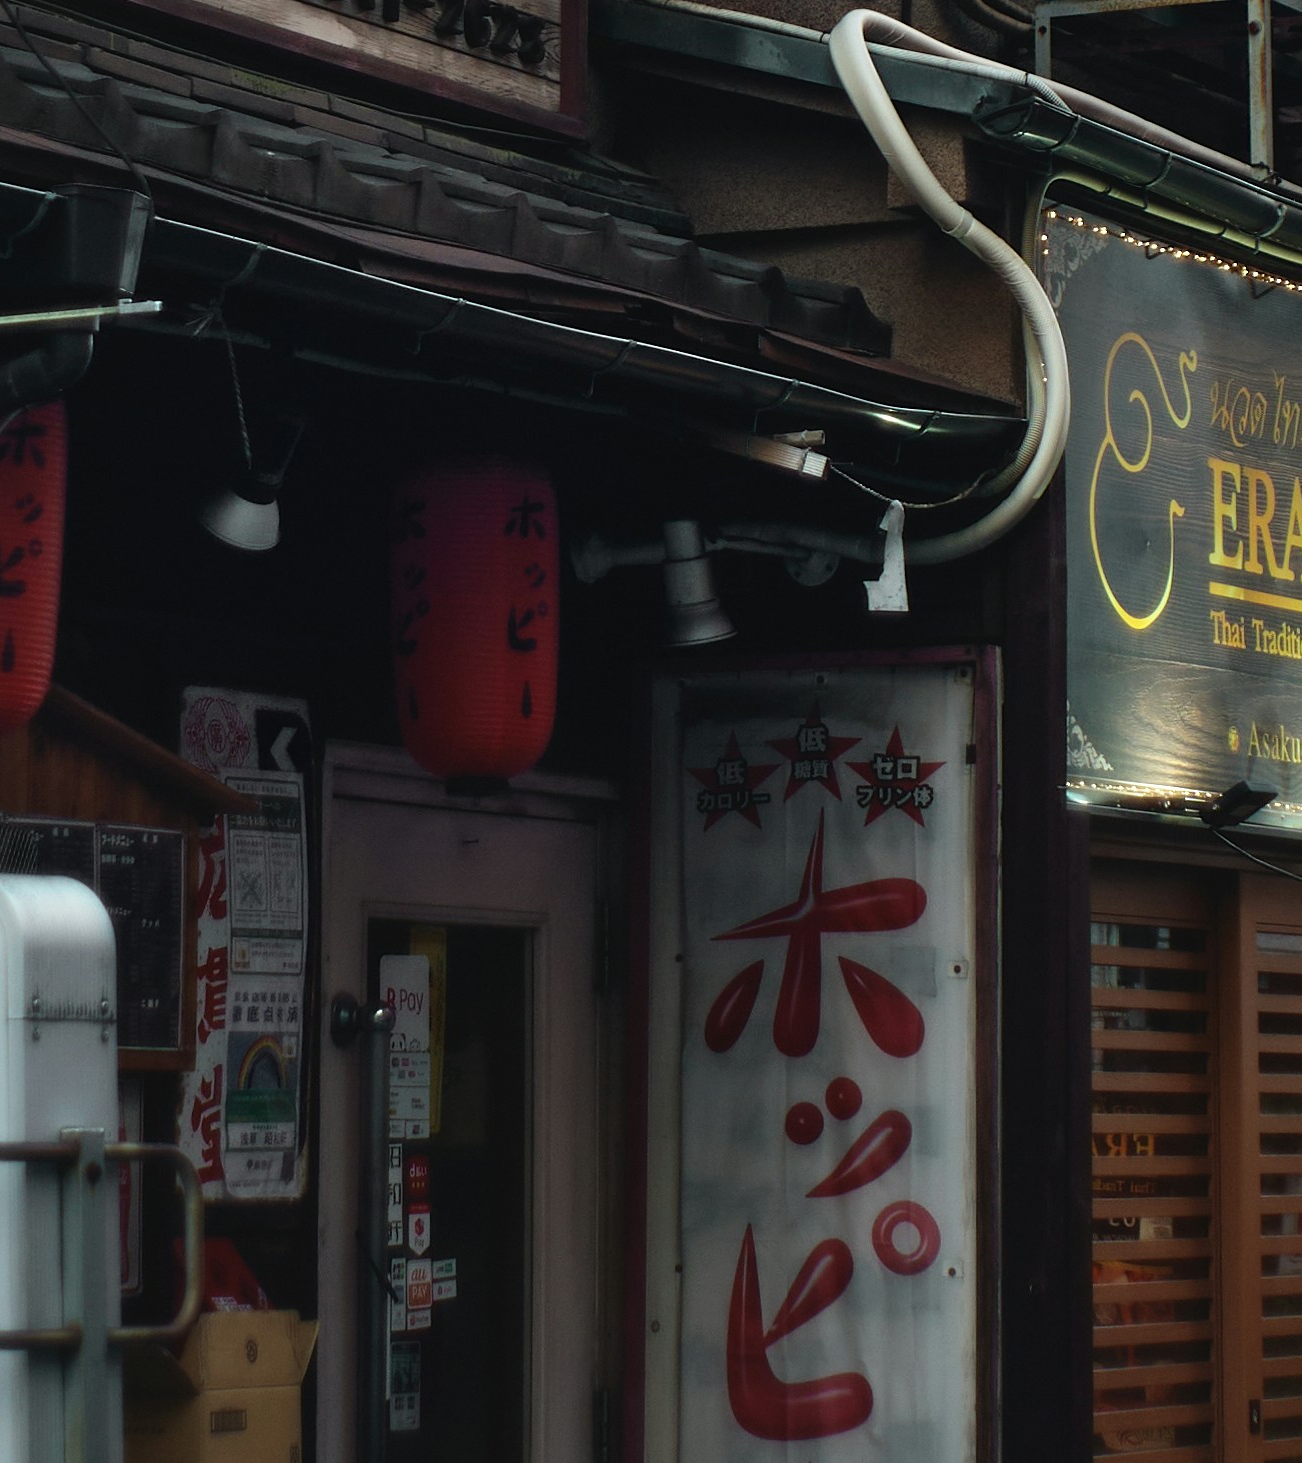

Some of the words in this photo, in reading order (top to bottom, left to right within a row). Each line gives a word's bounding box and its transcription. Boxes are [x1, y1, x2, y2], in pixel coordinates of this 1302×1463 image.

[504, 495, 550, 718] ホッピー
[1210, 609, 1246, 649] Thai
[798, 725, 828, 753] 低
[717, 760, 746, 785] 低
[793, 761, 830, 779] 糖質
[873, 755, 920, 781] ゼロ
[698, 792, 771, 812] カロリー
[857, 785, 934, 808] プリン体
[400, 989, 424, 1014] Pay
[411, 1286, 428, 1299] PAY
